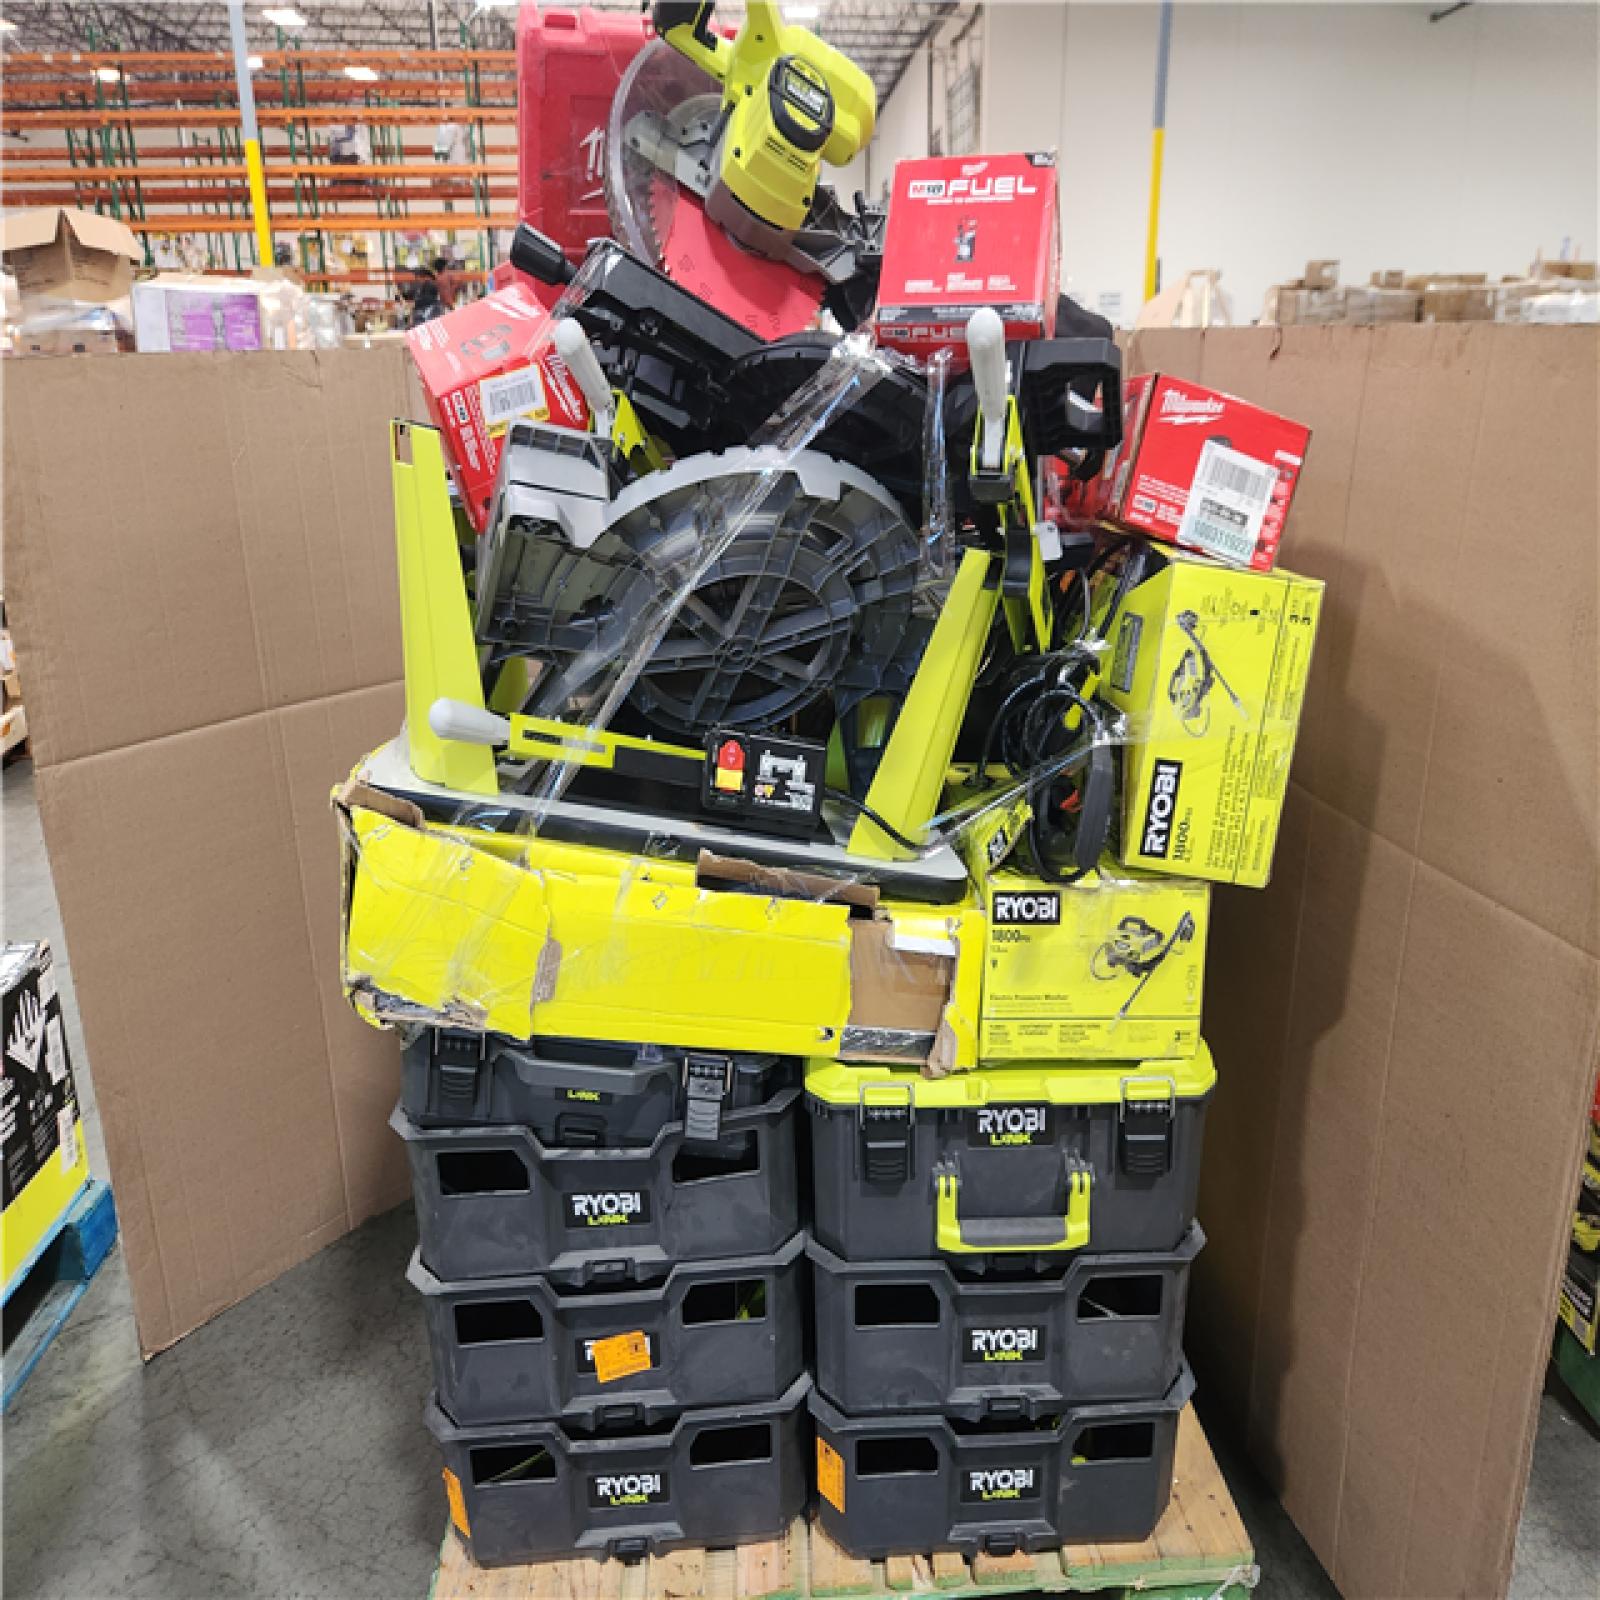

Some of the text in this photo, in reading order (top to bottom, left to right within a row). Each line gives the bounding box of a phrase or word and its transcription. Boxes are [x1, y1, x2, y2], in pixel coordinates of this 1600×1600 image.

[948, 175, 1036, 195] FUEL
[911, 326, 969, 338] FUE
[1143, 763, 1180, 855] RYOBI
[995, 896, 1058, 920] RYOBI
[977, 1107, 1046, 1133] RYOBI
[572, 1192, 640, 1215] RYOBI
[971, 1329, 1038, 1351] RYOBI
[595, 1474, 660, 1496] RYOBI
[970, 1469, 1033, 1491] RYOBI
